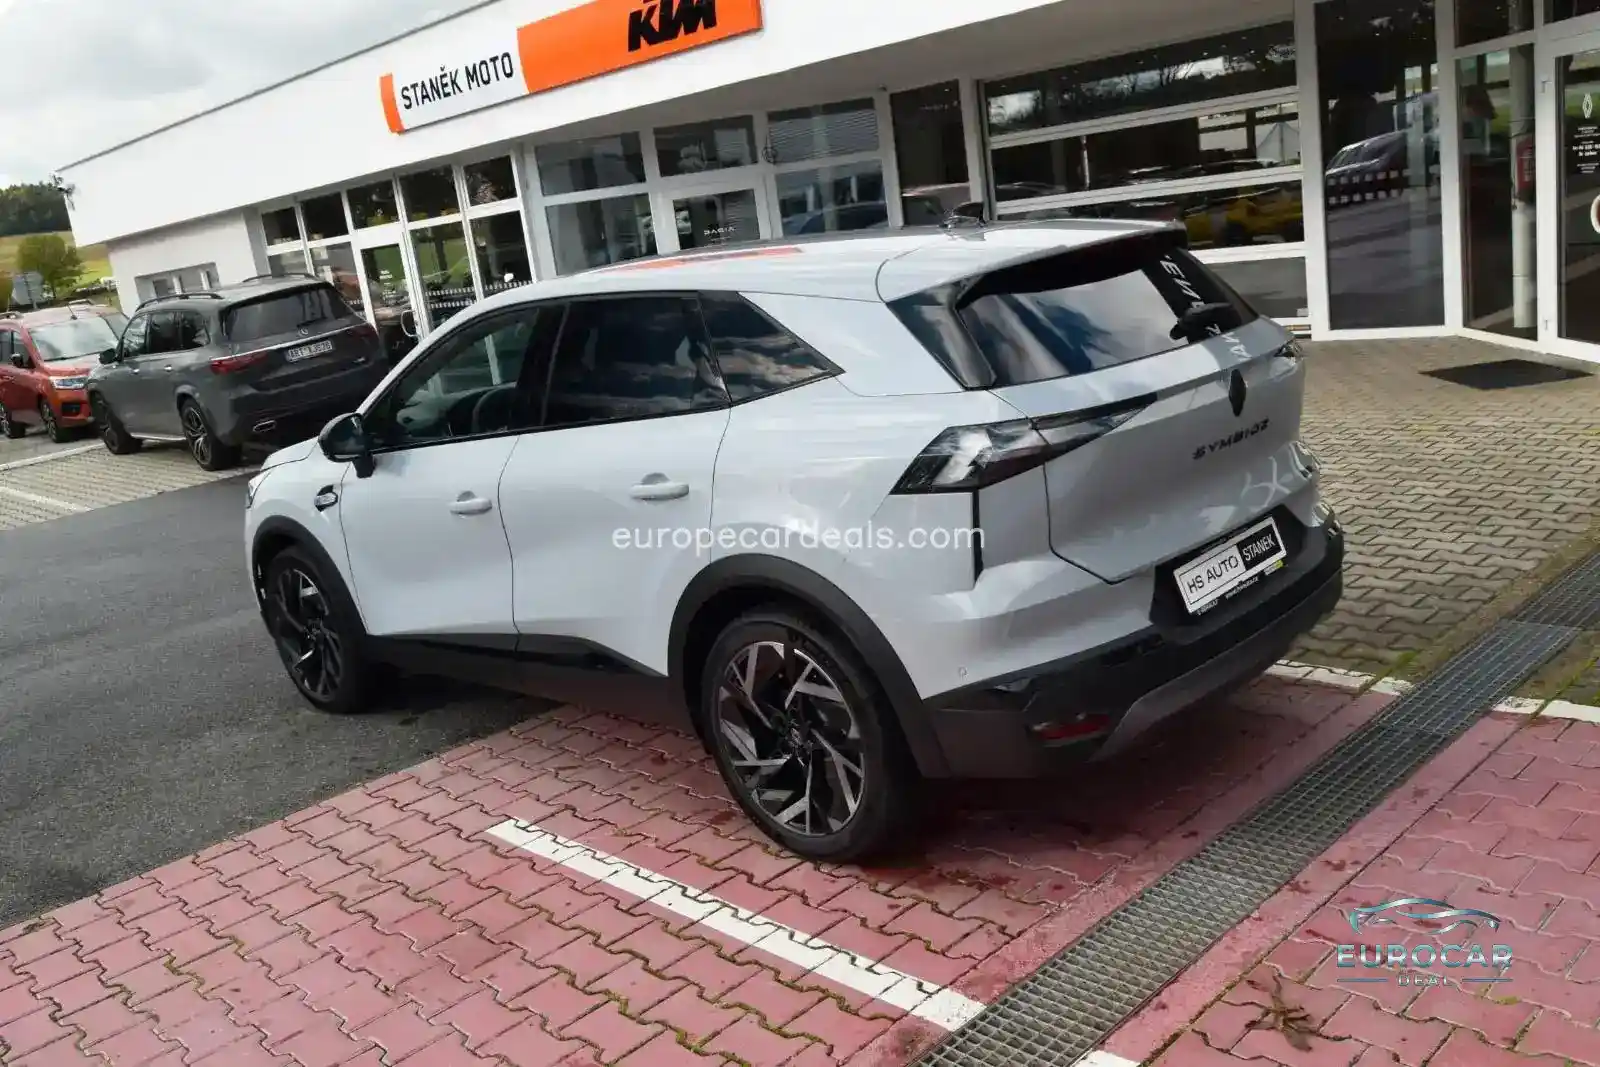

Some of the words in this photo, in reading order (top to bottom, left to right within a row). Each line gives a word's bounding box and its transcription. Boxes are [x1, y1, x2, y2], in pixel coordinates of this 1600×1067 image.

[628, 0, 717, 52] KTM
[401, 65, 464, 110] STANĚK
[465, 52, 514, 90] MOTO
[1192, 417, 1269, 460] SYMBIOZ
[1187, 574, 1205, 594] HS
[1207, 555, 1239, 583] AUTO
[1242, 533, 1276, 562] STANEK
